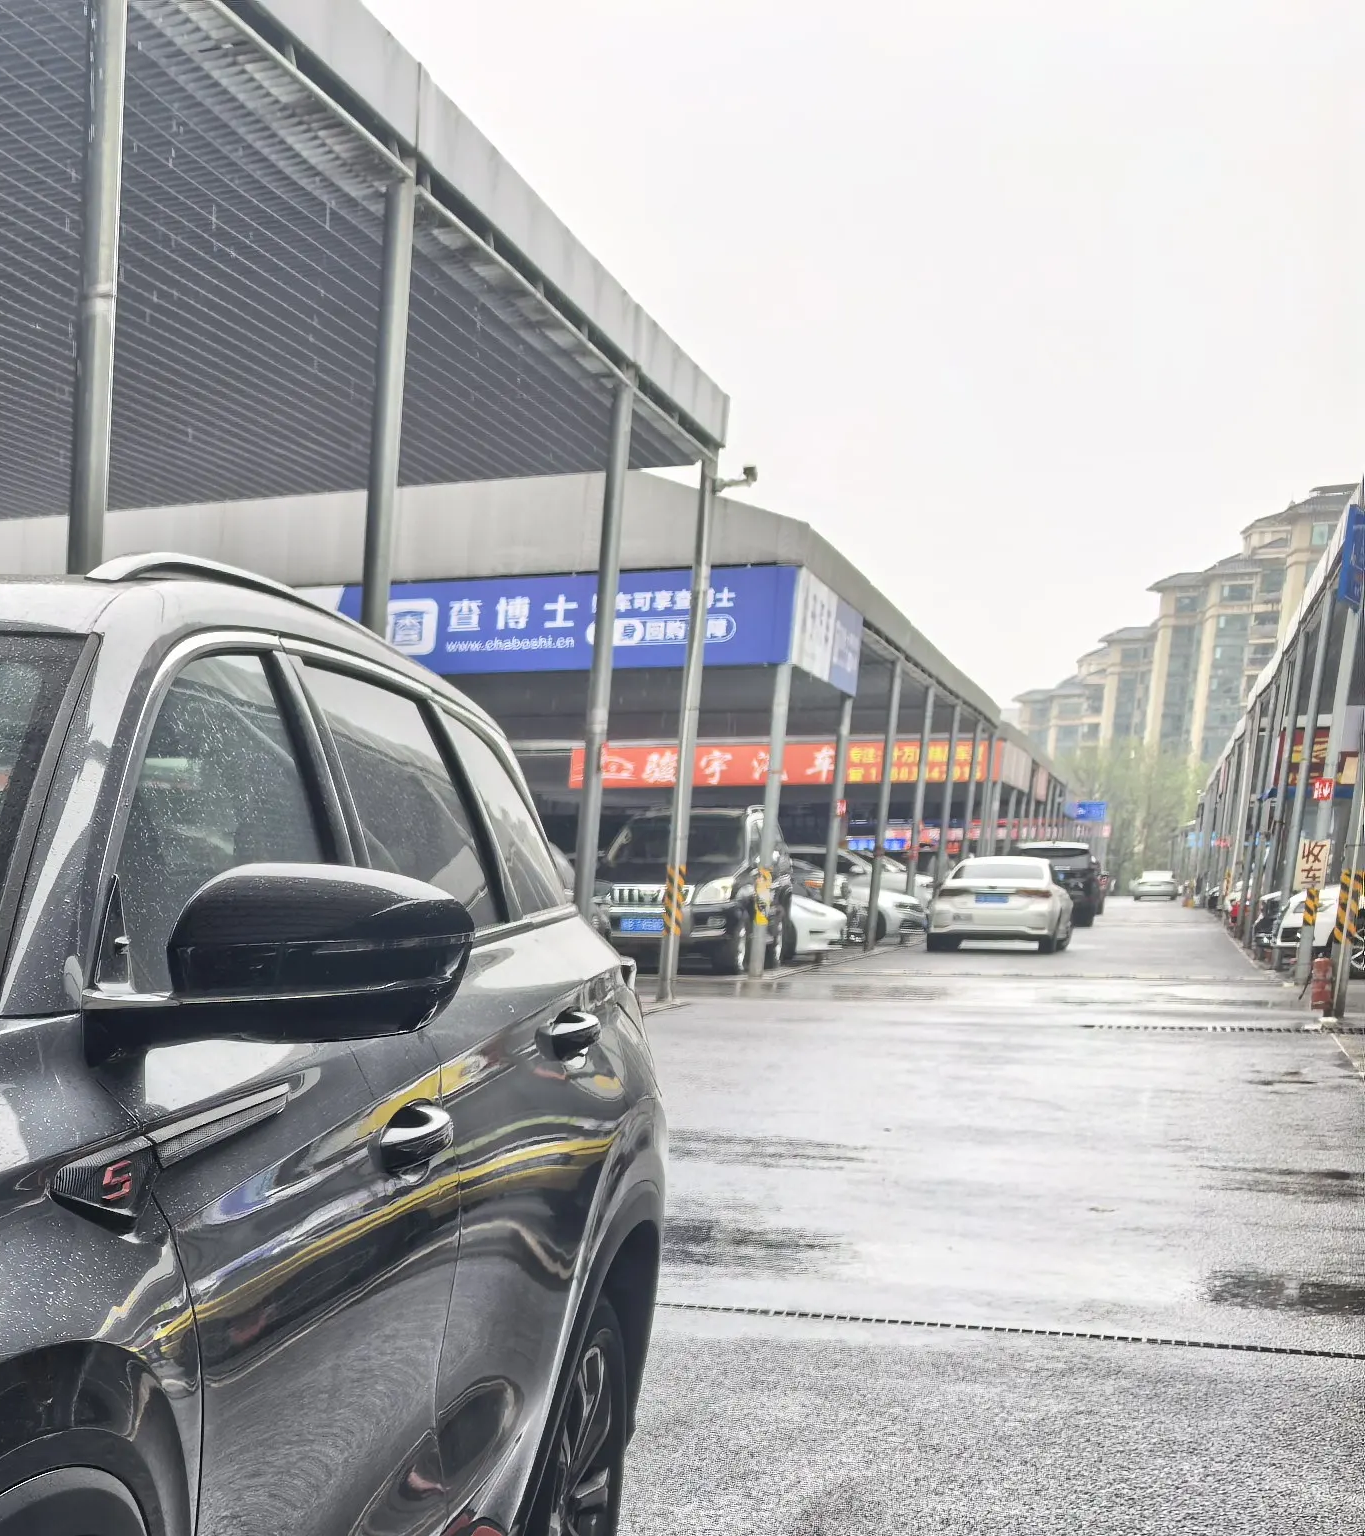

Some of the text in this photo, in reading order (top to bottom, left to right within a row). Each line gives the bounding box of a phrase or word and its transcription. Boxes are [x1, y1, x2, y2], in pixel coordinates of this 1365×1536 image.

[447, 593, 579, 632] 查博士
[591, 587, 736, 614] 车可享查士
[446, 635, 575, 653] www.chaboshi.cn
